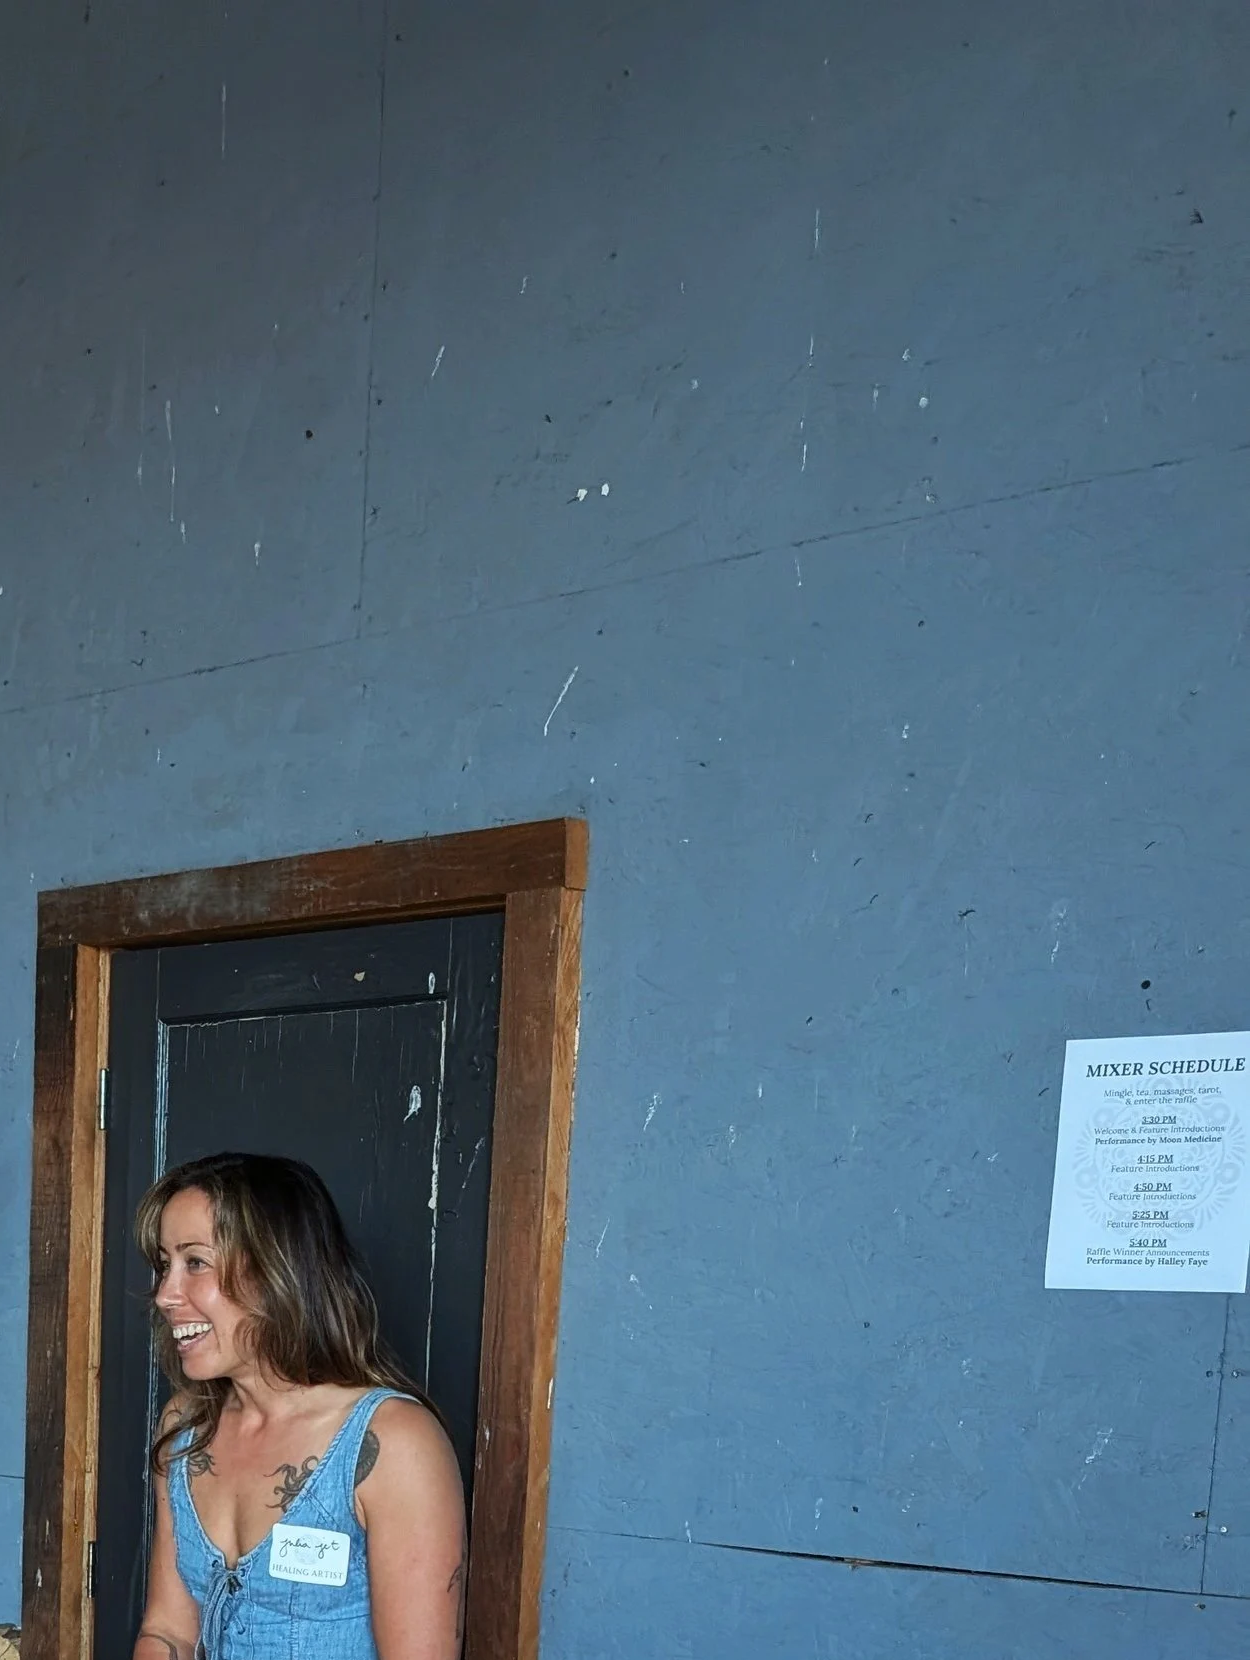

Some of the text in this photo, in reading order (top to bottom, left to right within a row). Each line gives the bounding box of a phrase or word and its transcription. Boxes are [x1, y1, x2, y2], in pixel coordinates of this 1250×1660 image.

[1085, 1057, 1246, 1078] MIXER SCHEDULE
[1103, 1089, 1134, 1099] Mingle,
[1153, 1087, 1196, 1097] massages,
[1198, 1086, 1222, 1095] tarot,
[1125, 1095, 1197, 1106] & enter the raffle
[1141, 1115, 1177, 1125] 3:30 PM
[1094, 1127, 1130, 1135] Welcome
[1138, 1126, 1169, 1134] Feature
[1170, 1125, 1225, 1134] Introductions
[1095, 1135, 1222, 1146] Performance by Moon Medicine
[1137, 1154, 1174, 1164] 4:15 PM
[1111, 1164, 1200, 1173] Feature Introductions
[1133, 1182, 1172, 1192] 4:50 PM
[1108, 1193, 1197, 1201] Feature Introductions
[1132, 1210, 1169, 1220] 5:25 PM
[1106, 1220, 1195, 1229] Feature Introductions
[1129, 1238, 1167, 1248] 5:40 PM
[1086, 1248, 1210, 1257] Raffle Winner Announcements
[1086, 1257, 1208, 1268] Performance by Halley Faye
[272, 1563, 344, 1581] HEALING ARTIST
